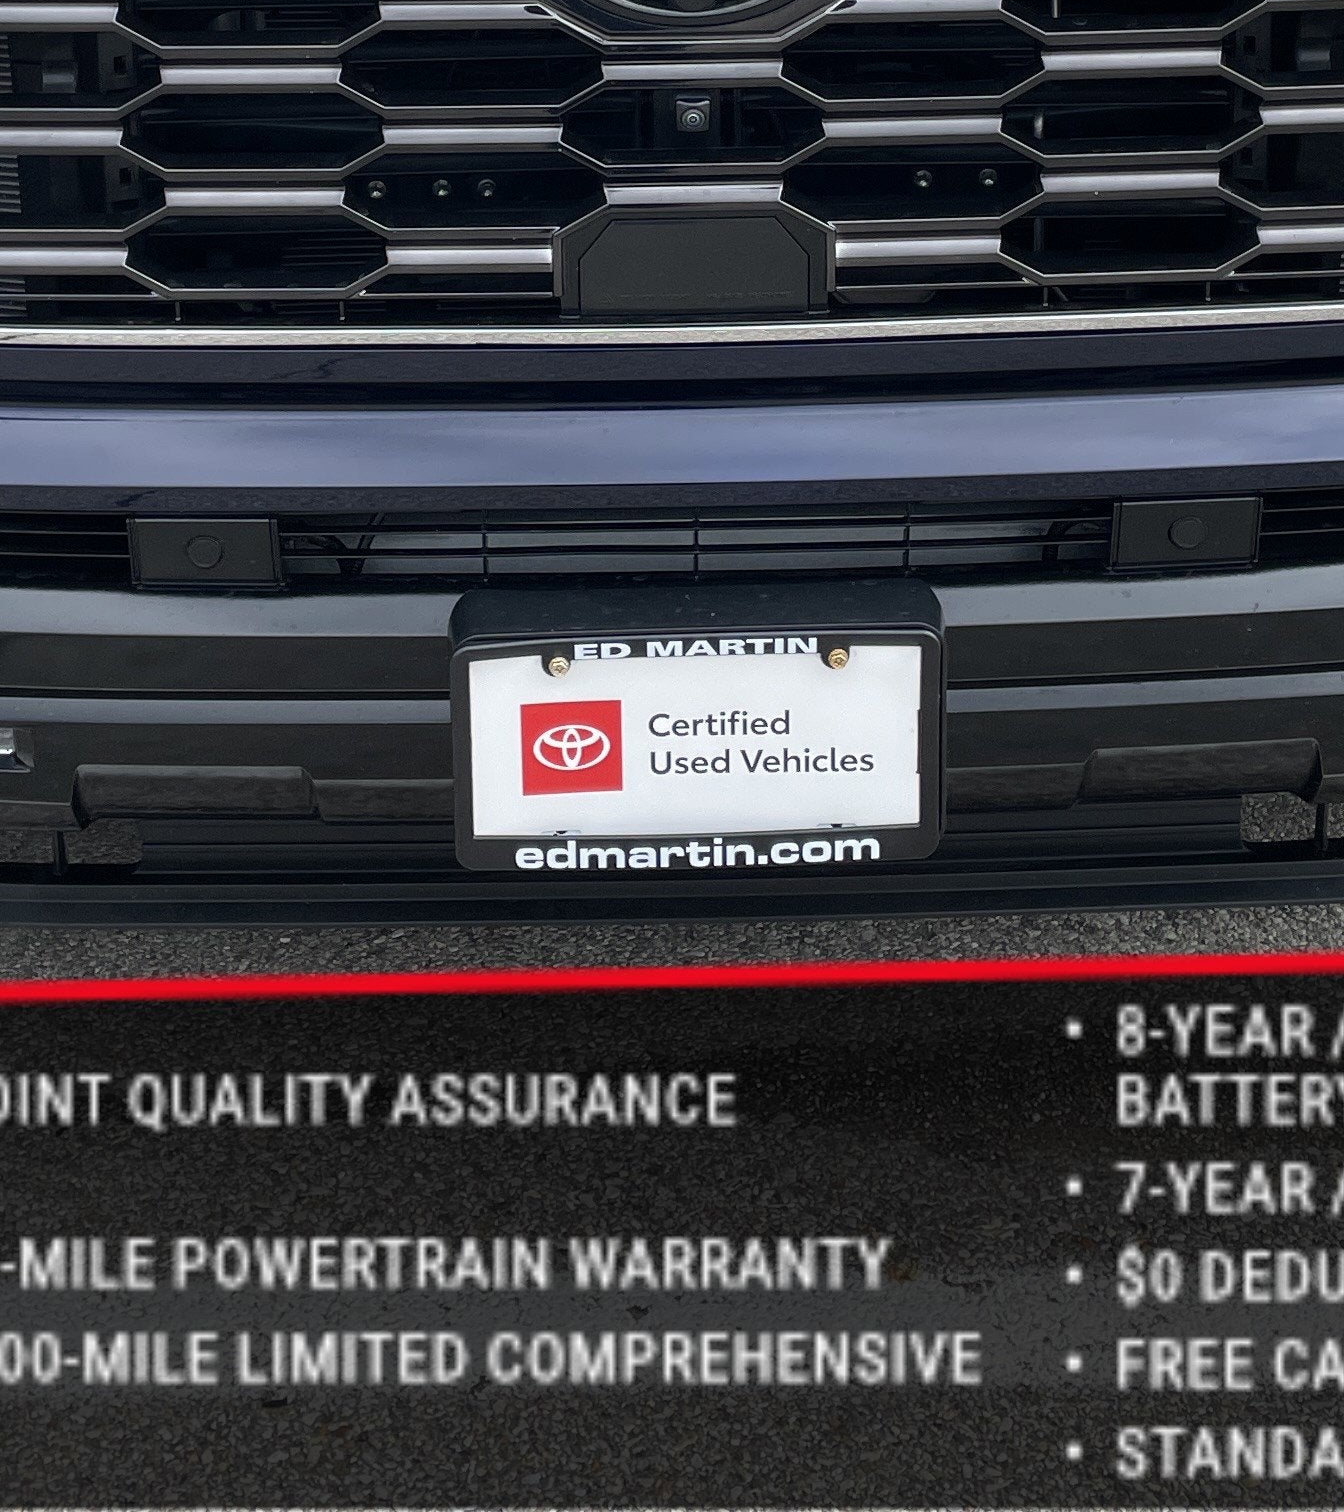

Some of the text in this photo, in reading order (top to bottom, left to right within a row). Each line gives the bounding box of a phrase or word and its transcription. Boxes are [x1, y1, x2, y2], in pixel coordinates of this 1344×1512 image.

[573, 636, 819, 661] ED MARTIN
[648, 709, 791, 738] Certified
[650, 747, 875, 775] Used Vehicles
[514, 837, 881, 871] edmartin.com
